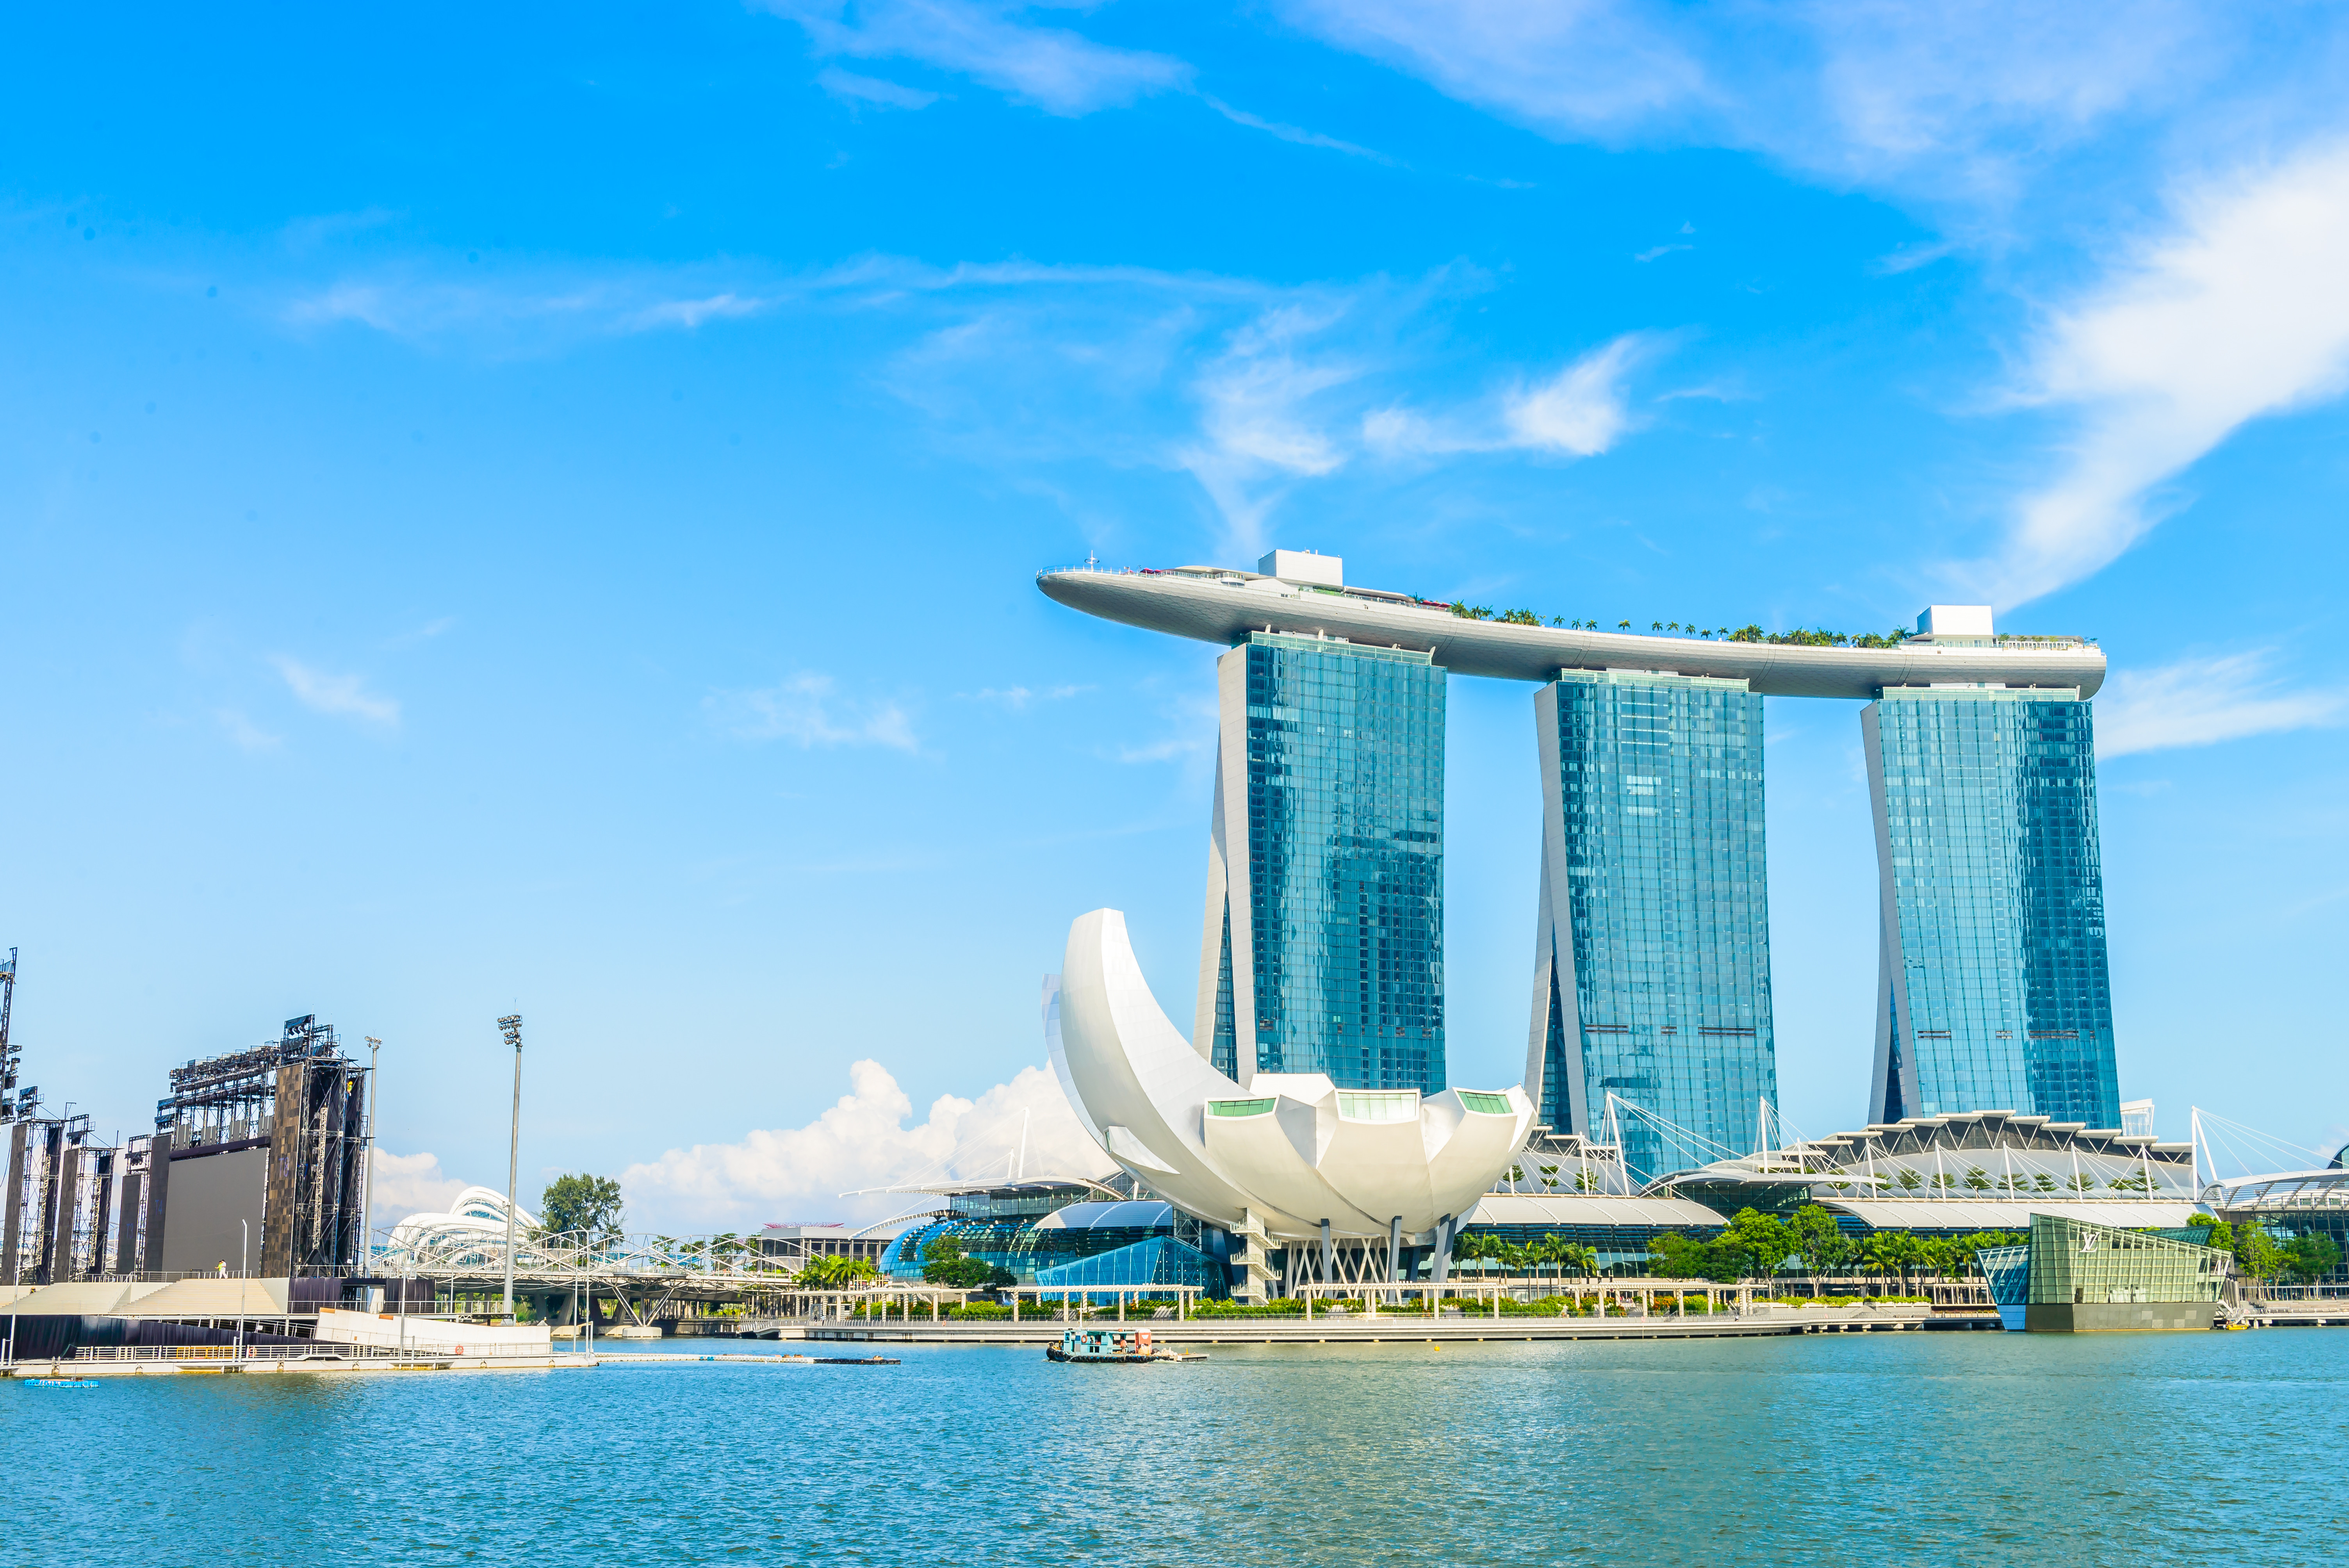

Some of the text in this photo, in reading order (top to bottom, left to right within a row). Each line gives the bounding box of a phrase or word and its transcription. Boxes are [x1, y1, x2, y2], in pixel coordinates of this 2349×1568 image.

[278, 1156, 289, 1177] T8
[155, 1199, 162, 1215] T4
[127, 1223, 134, 1239] T3
